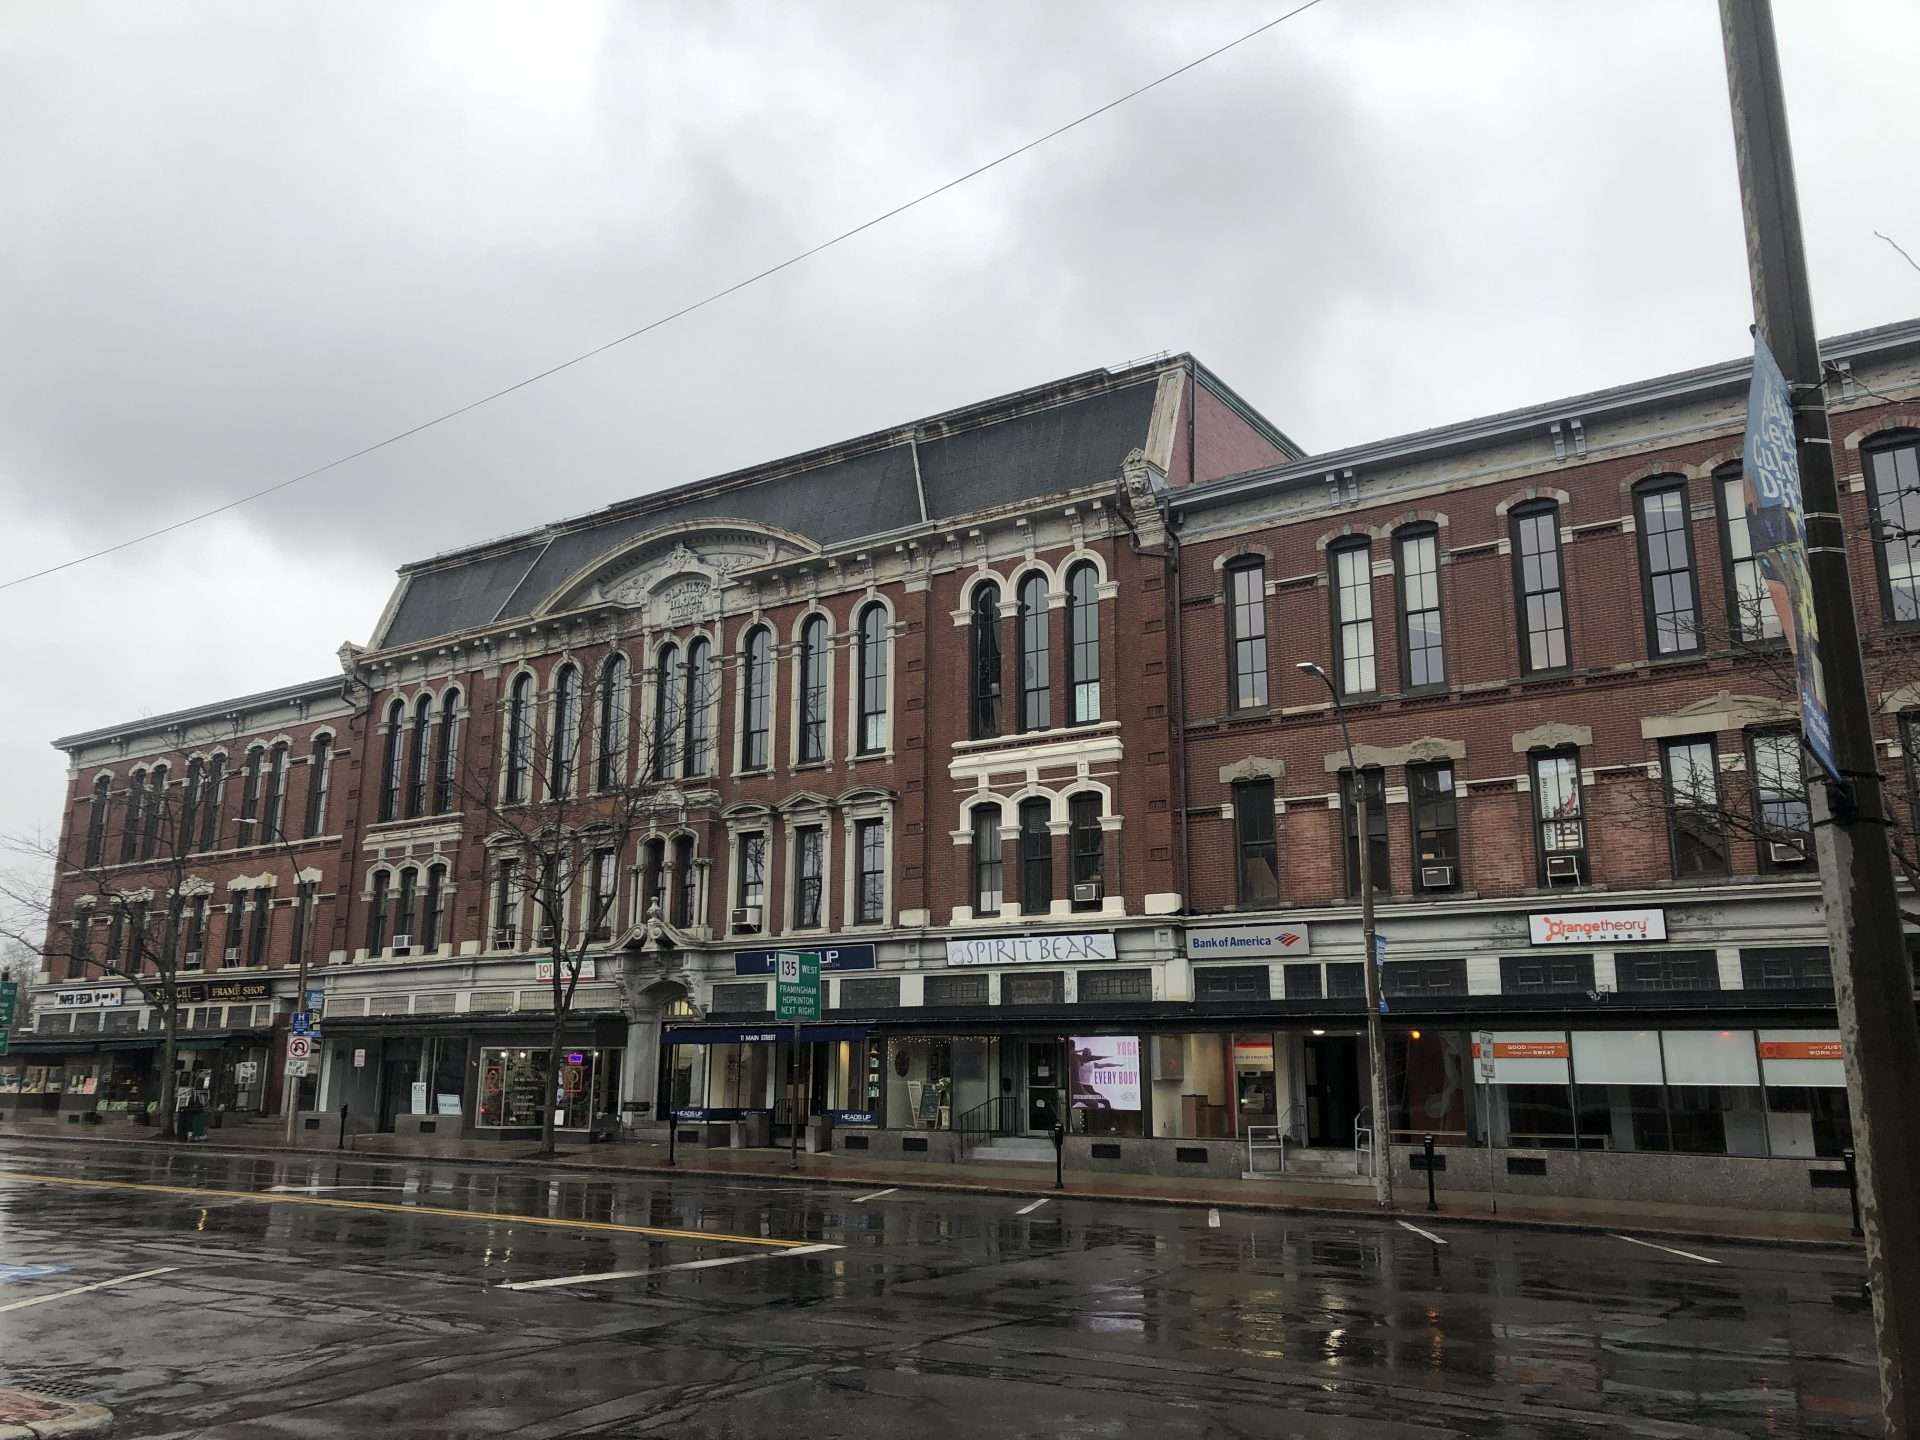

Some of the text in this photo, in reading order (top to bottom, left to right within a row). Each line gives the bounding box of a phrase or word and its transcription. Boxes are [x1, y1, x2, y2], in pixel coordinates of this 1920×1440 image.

[1192, 936, 1272, 949] Bank of America
[1564, 933, 1647, 941] FITNESS
[966, 935, 1107, 964] SPIRIT BEAR
[781, 960, 797, 977] 135
[801, 964, 818, 975] WEST
[242, 985, 265, 996] SHOP
[779, 985, 817, 995] FRAMINGHAM
[782, 995, 814, 1005] HOPKINTON
[781, 1006, 816, 1016] NEXT RIGHT
[1117, 1041, 1137, 1057] YOGA
[1094, 1071, 1138, 1085] EVERY BODY
